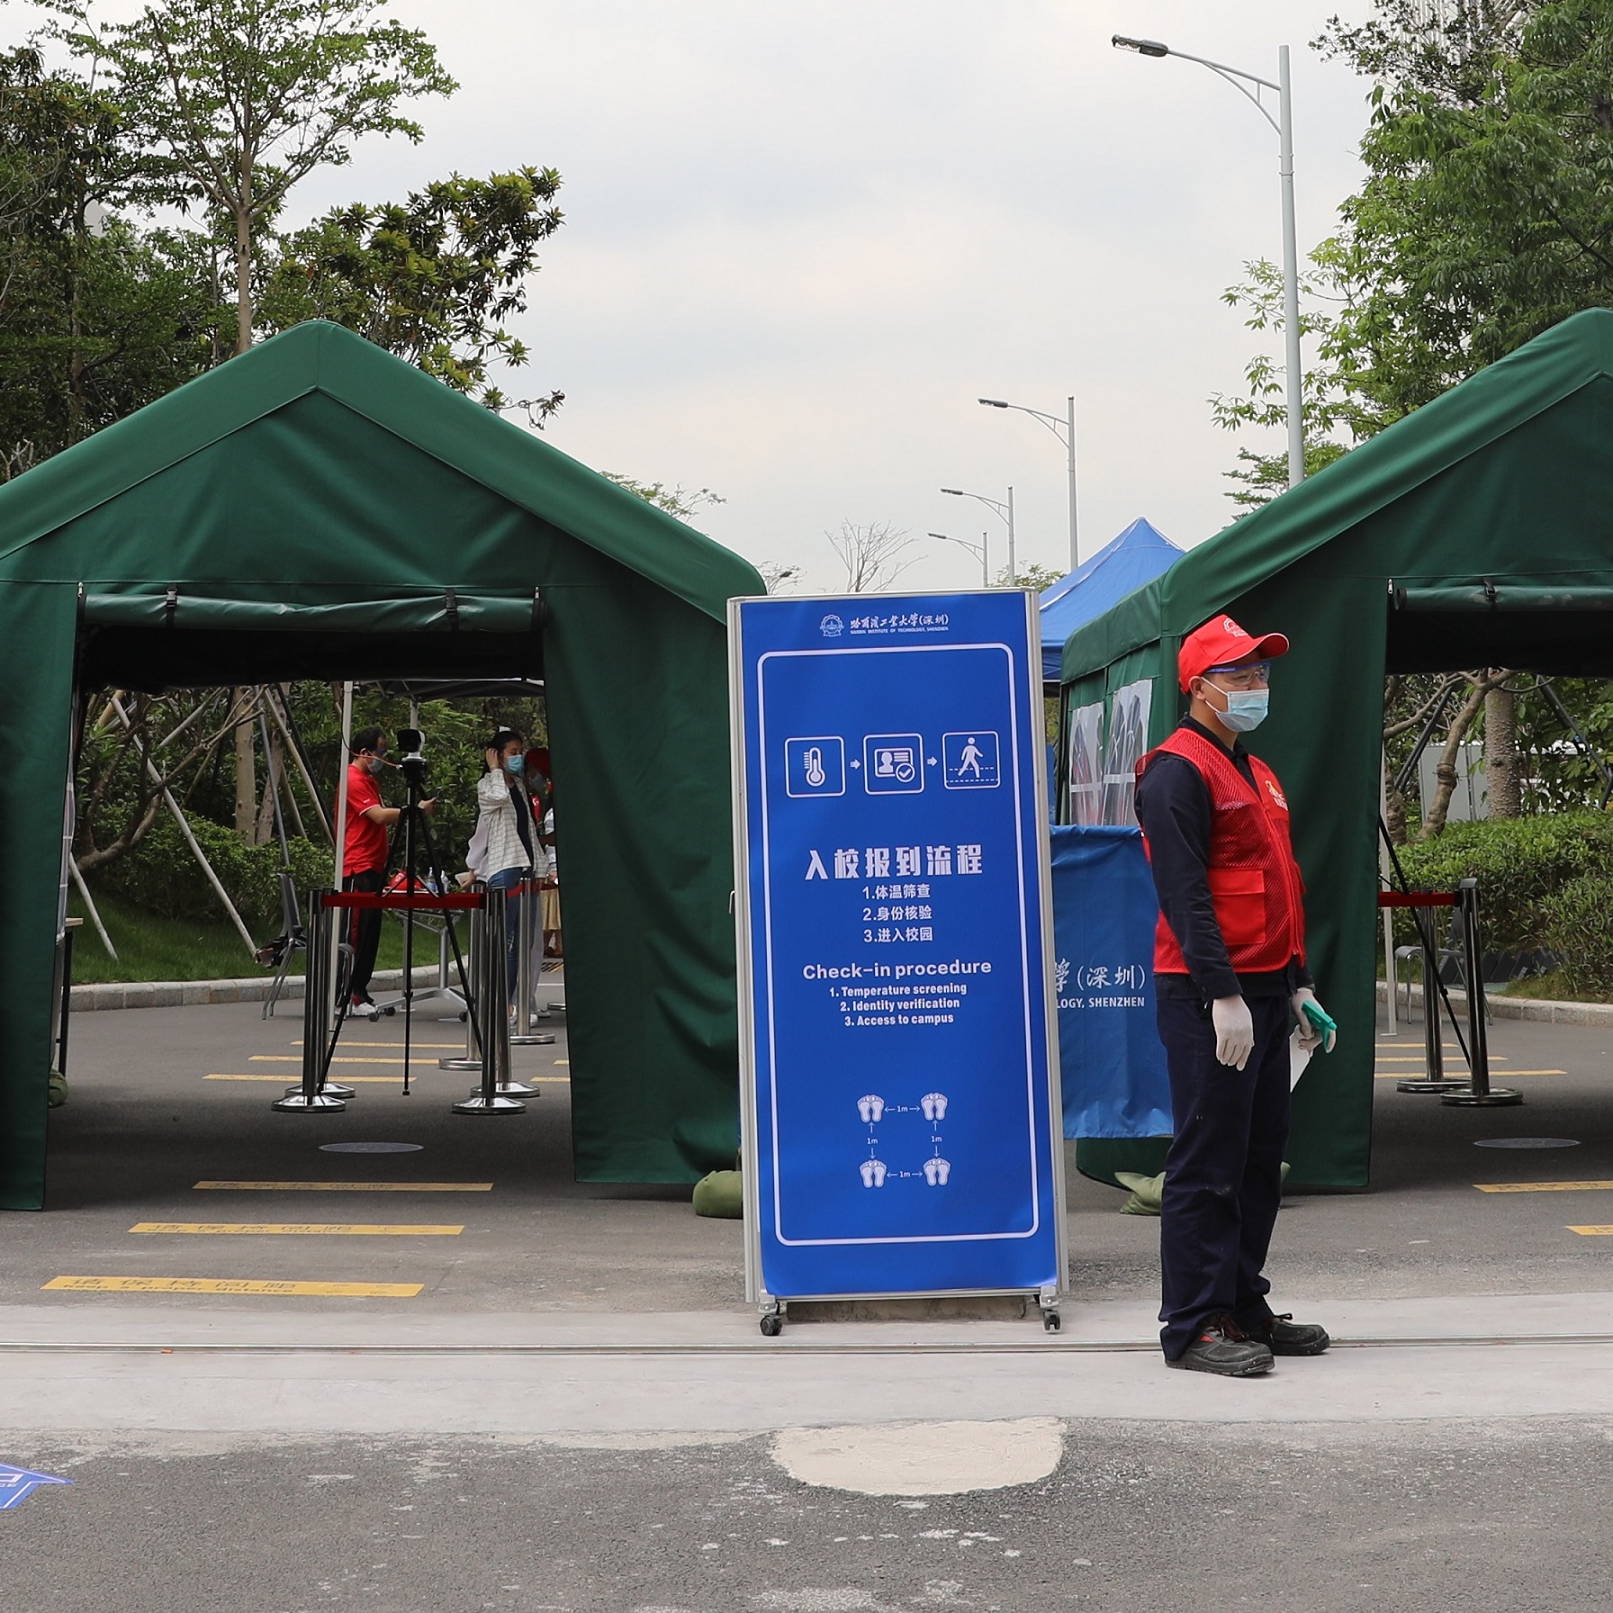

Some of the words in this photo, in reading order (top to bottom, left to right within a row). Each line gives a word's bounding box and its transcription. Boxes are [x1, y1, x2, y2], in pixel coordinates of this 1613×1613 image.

[804, 844, 983, 880] 入校报到流程
[862, 883, 931, 900] 1.体温筛查
[862, 905, 933, 921] 2.身份核验
[863, 927, 933, 943] 3.进入校园
[803, 963, 891, 980] Check-in
[895, 959, 992, 979] procedure
[829, 987, 839, 998] 1.
[841, 985, 911, 998] Temperature
[913, 982, 967, 995] screening
[840, 1002, 850, 1012] 2.
[852, 1000, 895, 1013] Identity
[897, 997, 960, 1010] verification
[1089, 996, 1145, 1008] SHENZHEN
[845, 1016, 855, 1026] 3.
[857, 1015, 896, 1026] Access
[898, 1014, 909, 1024] to
[911, 1014, 954, 1026] campus
